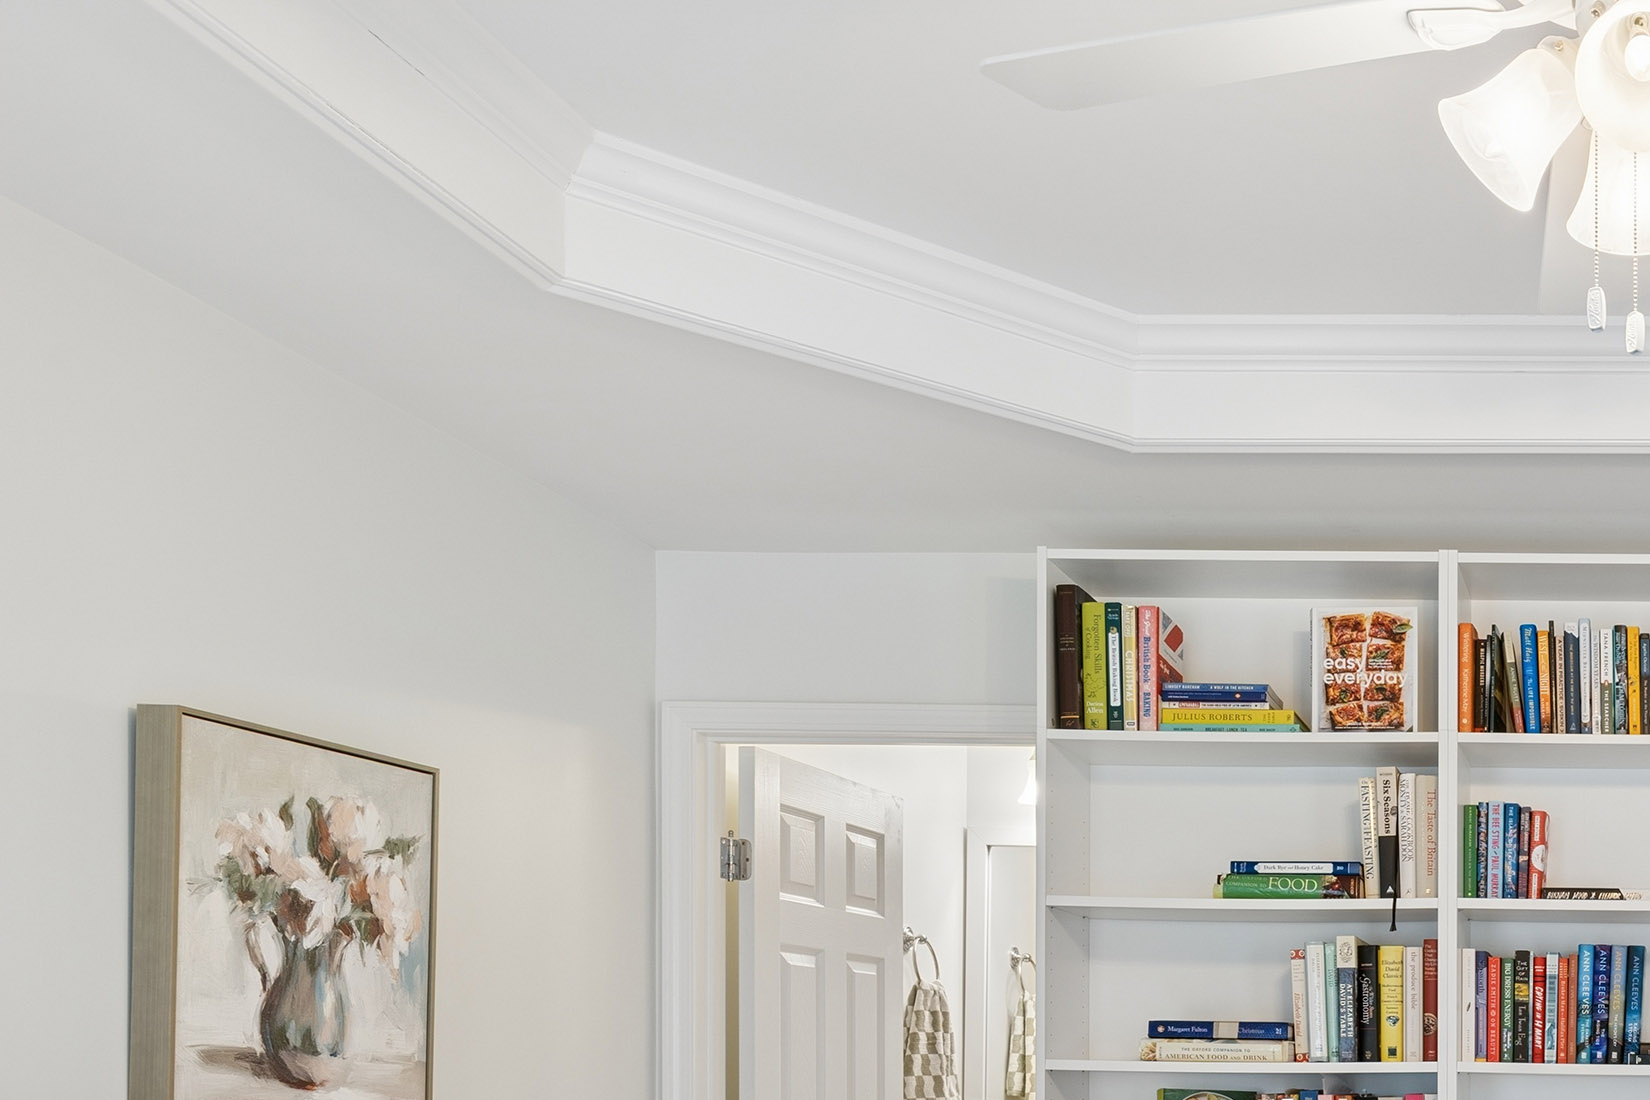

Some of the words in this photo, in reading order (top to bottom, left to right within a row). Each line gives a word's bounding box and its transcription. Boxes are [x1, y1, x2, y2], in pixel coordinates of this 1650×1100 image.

[1092, 614, 1101, 651] Forgotten
[1094, 654, 1103, 674] Skills
[1324, 658, 1363, 672] easy
[1125, 651, 1134, 702] CHRISTMAS
[1324, 670, 1407, 687] everyday
[1172, 713, 1206, 721] JULIUS
[1209, 713, 1253, 721] ROBERTS
[1427, 789, 1436, 807] The
[1383, 796, 1391, 834] Seasons
[1427, 810, 1436, 832] Taste
[1427, 835, 1436, 844] of
[1427, 847, 1436, 876] Britain
[1268, 876, 1318, 892] FOOD
[1347, 984, 1352, 994] AT
[1613, 974, 1621, 1010] CLEEVES
[1360, 977, 1371, 1025] Gastronomy
